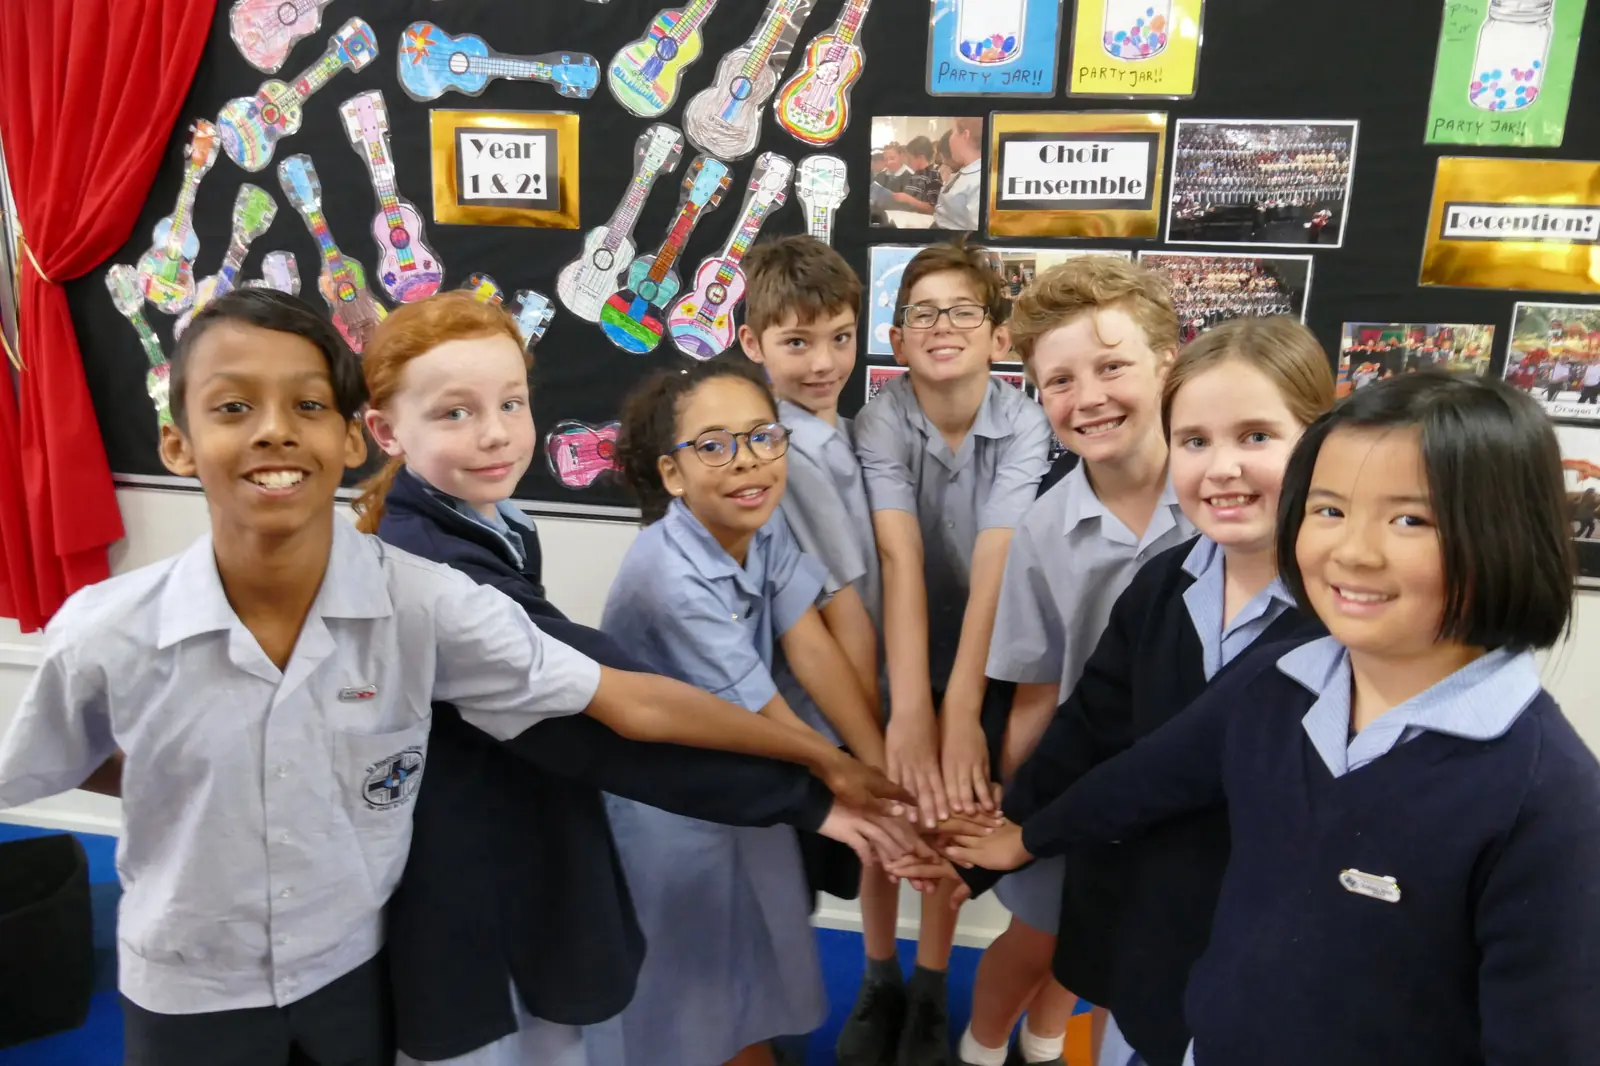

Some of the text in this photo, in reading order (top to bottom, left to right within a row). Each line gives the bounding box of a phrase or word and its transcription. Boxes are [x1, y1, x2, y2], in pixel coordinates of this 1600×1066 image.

[938, 61, 1043, 86] PARTY JAR!!
[1079, 66, 1163, 87] PARTY JAR!!
[1432, 117, 1484, 139] PARTY
[469, 138, 536, 159] Year
[1039, 144, 1114, 164] Choir
[469, 173, 542, 194] 1 & 2!
[1007, 176, 1142, 195] Ensemble
[1450, 212, 1593, 232] Reception!
